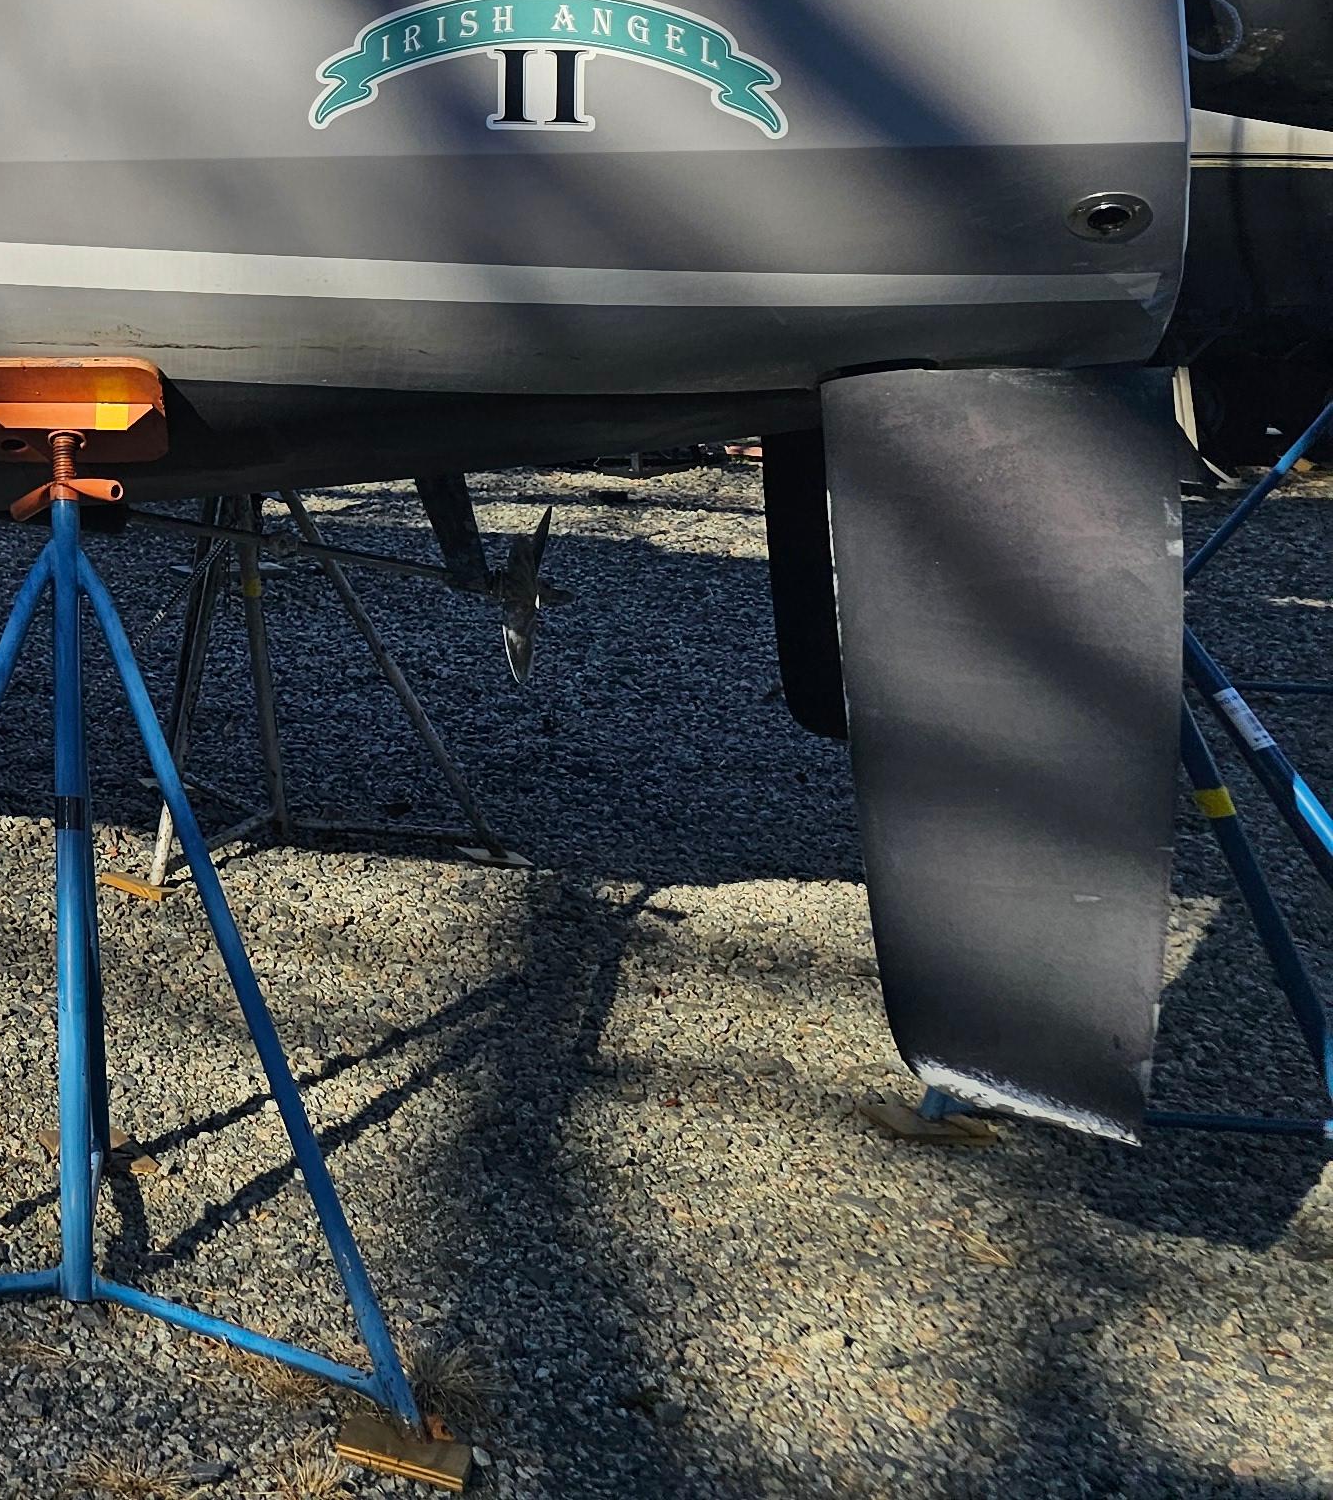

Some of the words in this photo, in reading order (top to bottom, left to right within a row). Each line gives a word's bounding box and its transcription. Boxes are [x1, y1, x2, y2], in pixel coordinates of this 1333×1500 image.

[381, 5, 515, 62] IRISH
[551, 4, 721, 70] ANGEL
[492, 49, 590, 126] II
